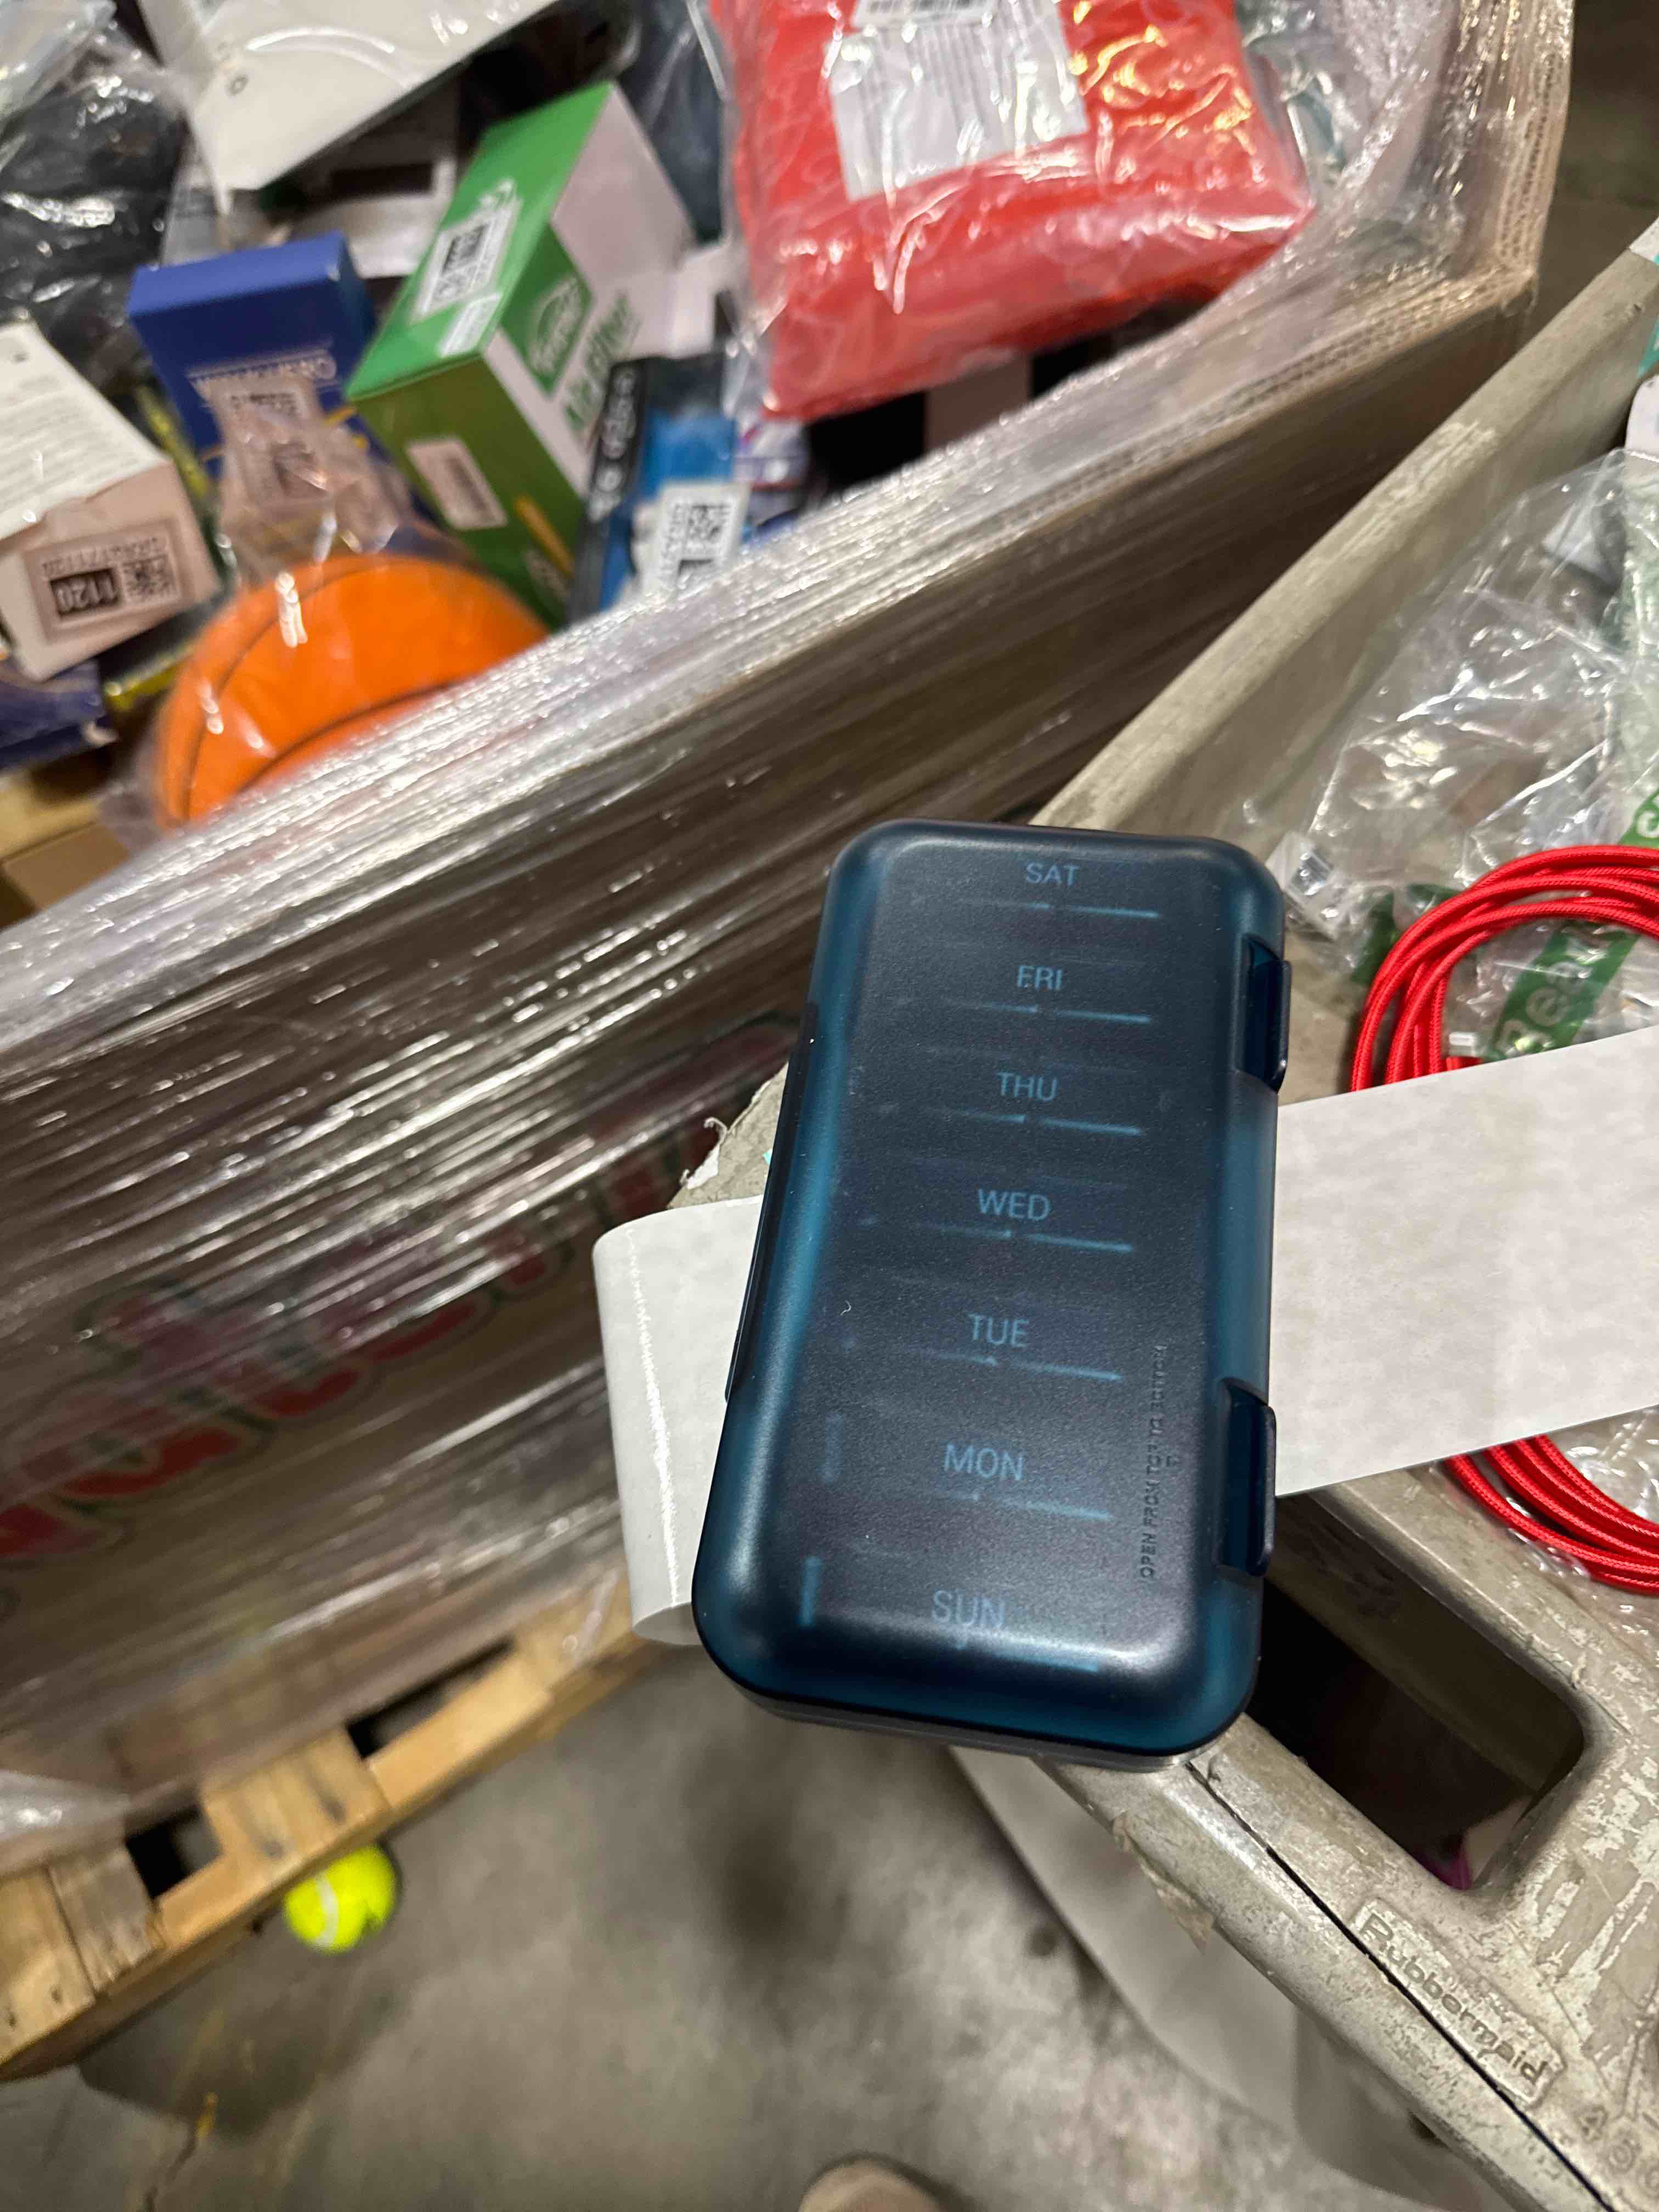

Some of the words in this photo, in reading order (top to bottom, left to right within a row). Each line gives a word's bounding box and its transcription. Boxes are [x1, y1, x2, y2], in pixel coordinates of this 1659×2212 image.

[1025, 861, 1080, 888] SAT
[1018, 965, 1063, 991] FRI
[996, 1071, 1058, 1102] THU
[977, 1188, 1052, 1221] WED
[967, 1313, 1029, 1347] TUE
[943, 1443, 1024, 1482] MON
[1147, 1443, 1161, 1475] TOP
[1143, 1480, 1161, 1527] FROM
[1139, 1532, 1157, 1578] OPEN
[931, 1589, 1007, 1629] SUN
[1358, 1911, 1549, 2085] Rubbermaid
